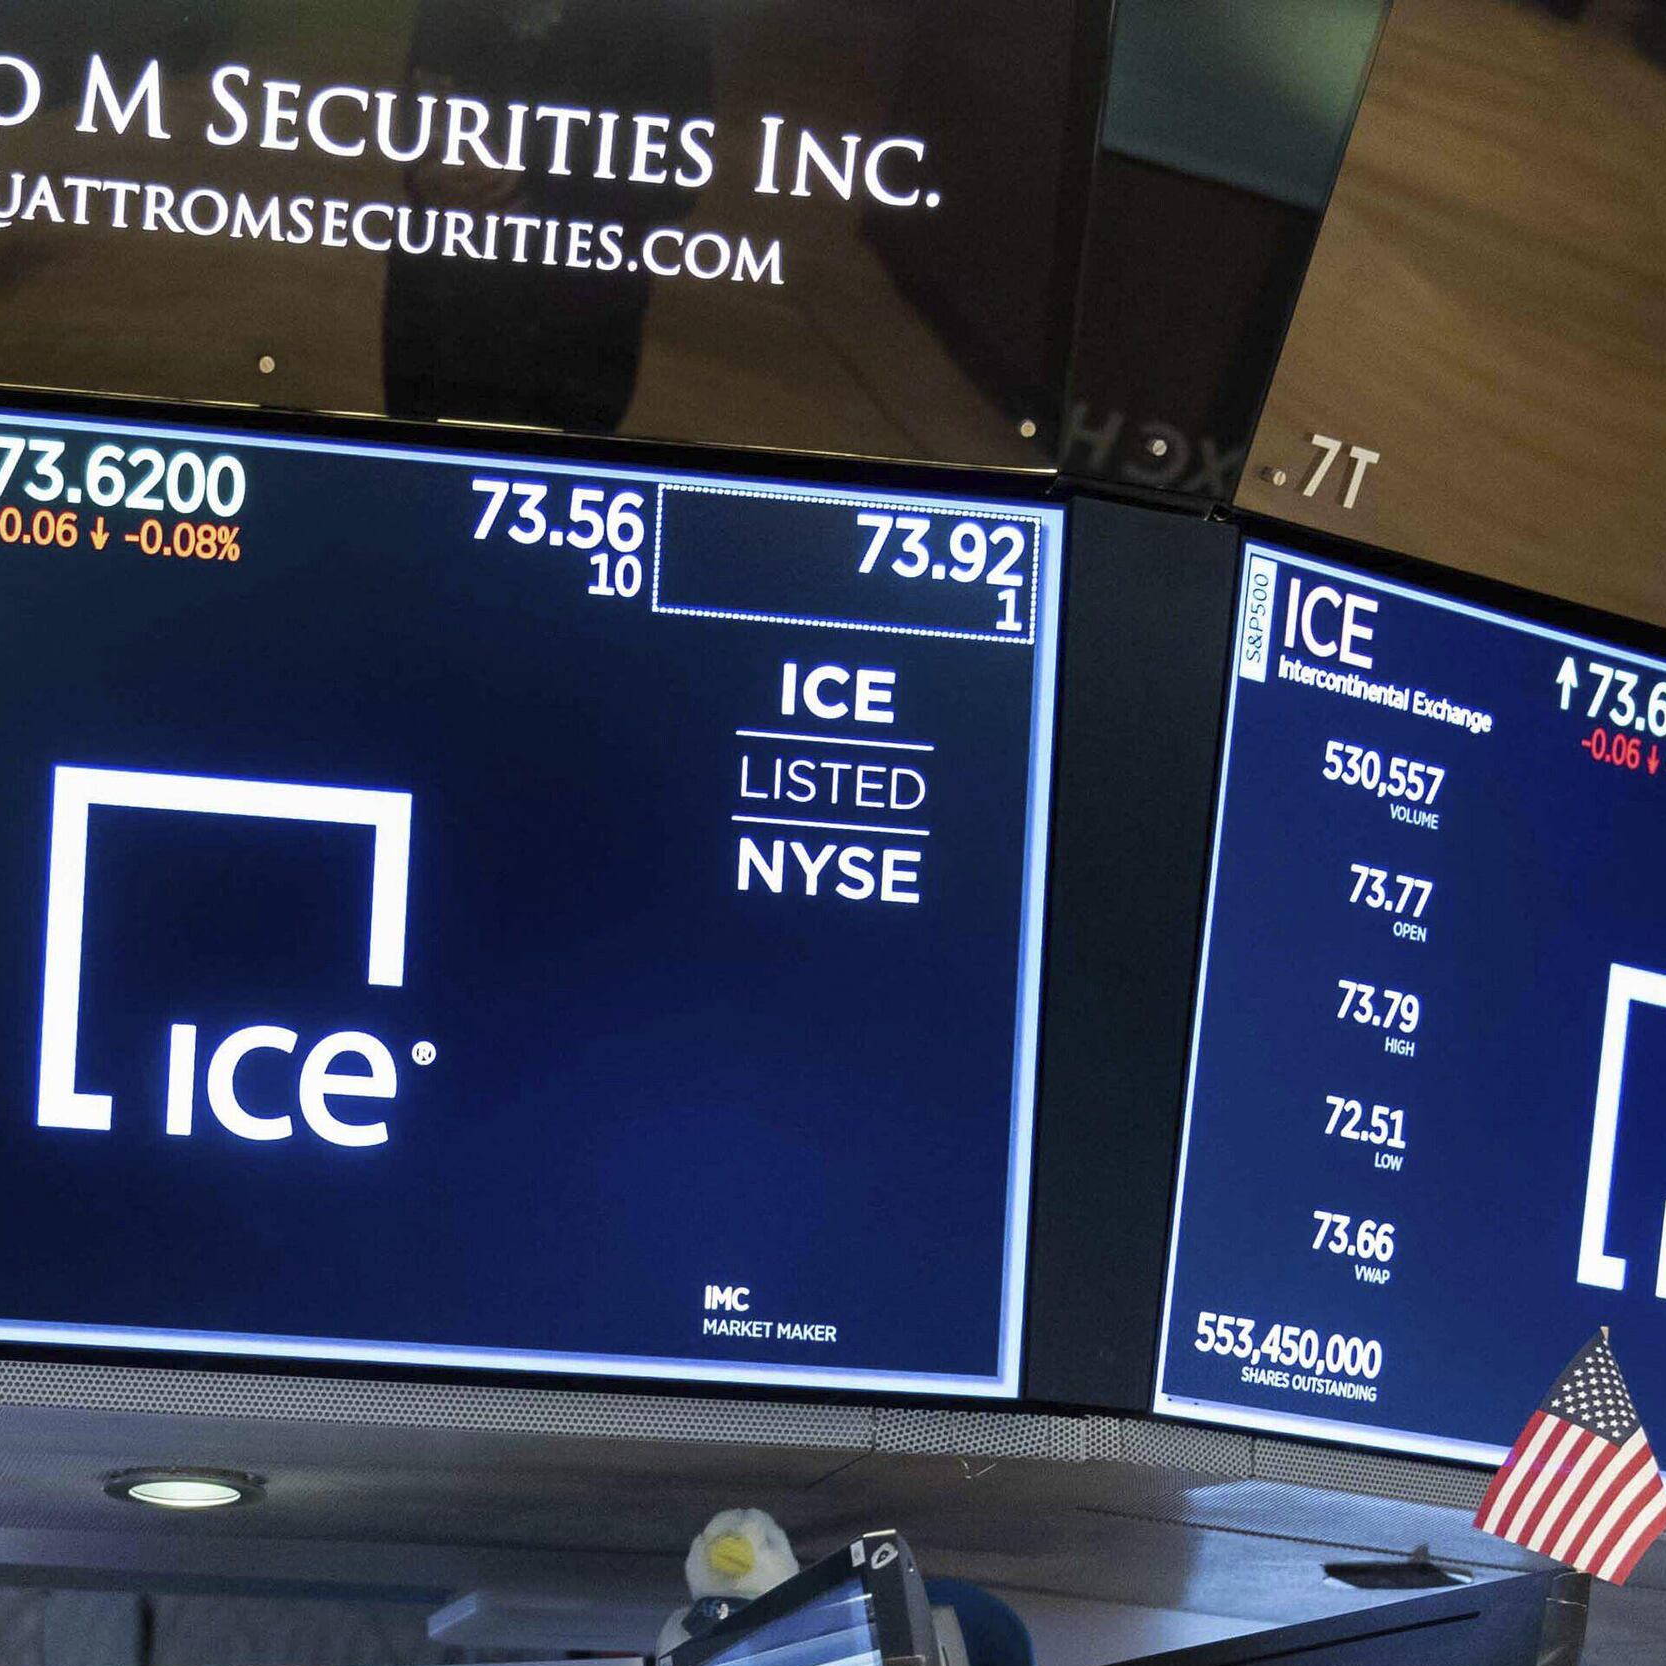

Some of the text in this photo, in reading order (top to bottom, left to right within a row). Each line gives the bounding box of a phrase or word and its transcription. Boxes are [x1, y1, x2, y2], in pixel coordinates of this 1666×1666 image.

[75, 53, 172, 140] M
[205, 64, 716, 188] SECURITIES
[754, 116, 941, 208] INC.
[1302, 433, 1381, 510] 7T
[124, 518, 241, 562] -0.08%
[471, 478, 645, 553] 73.56
[588, 552, 643, 598] 10
[856, 513, 1025, 587] 73.92
[995, 588, 1023, 632] 1
[1244, 572, 1270, 664] S&P500
[1283, 577, 1379, 670] ICE
[781, 662, 896, 724] ICE
[1279, 655, 1493, 734] Intercontinental Exchange
[1322, 740, 1446, 805] 530,557
[1581, 735, 1642, 771] -0.06
[740, 755, 926, 810] LISTED
[1389, 803, 1440, 830] VOLUME
[737, 837, 922, 904] NYSE
[1349, 863, 1434, 918] 73.77
[1392, 921, 1427, 943] OPEN
[1337, 979, 1420, 1034] 73.79
[1384, 1036, 1416, 1057] HIGH
[1324, 1095, 1406, 1149] 72.51
[1374, 1151, 1404, 1172] LOW
[1312, 1210, 1396, 1263] 73.66
[704, 1284, 750, 1312] IMC
[1354, 1264, 1391, 1285] VWAP
[702, 1318, 837, 1343] MARKET MAKER
[1194, 1311, 1383, 1380] 553,450,000
[1240, 1366, 1379, 1403] SHARES OUTSTANDING
